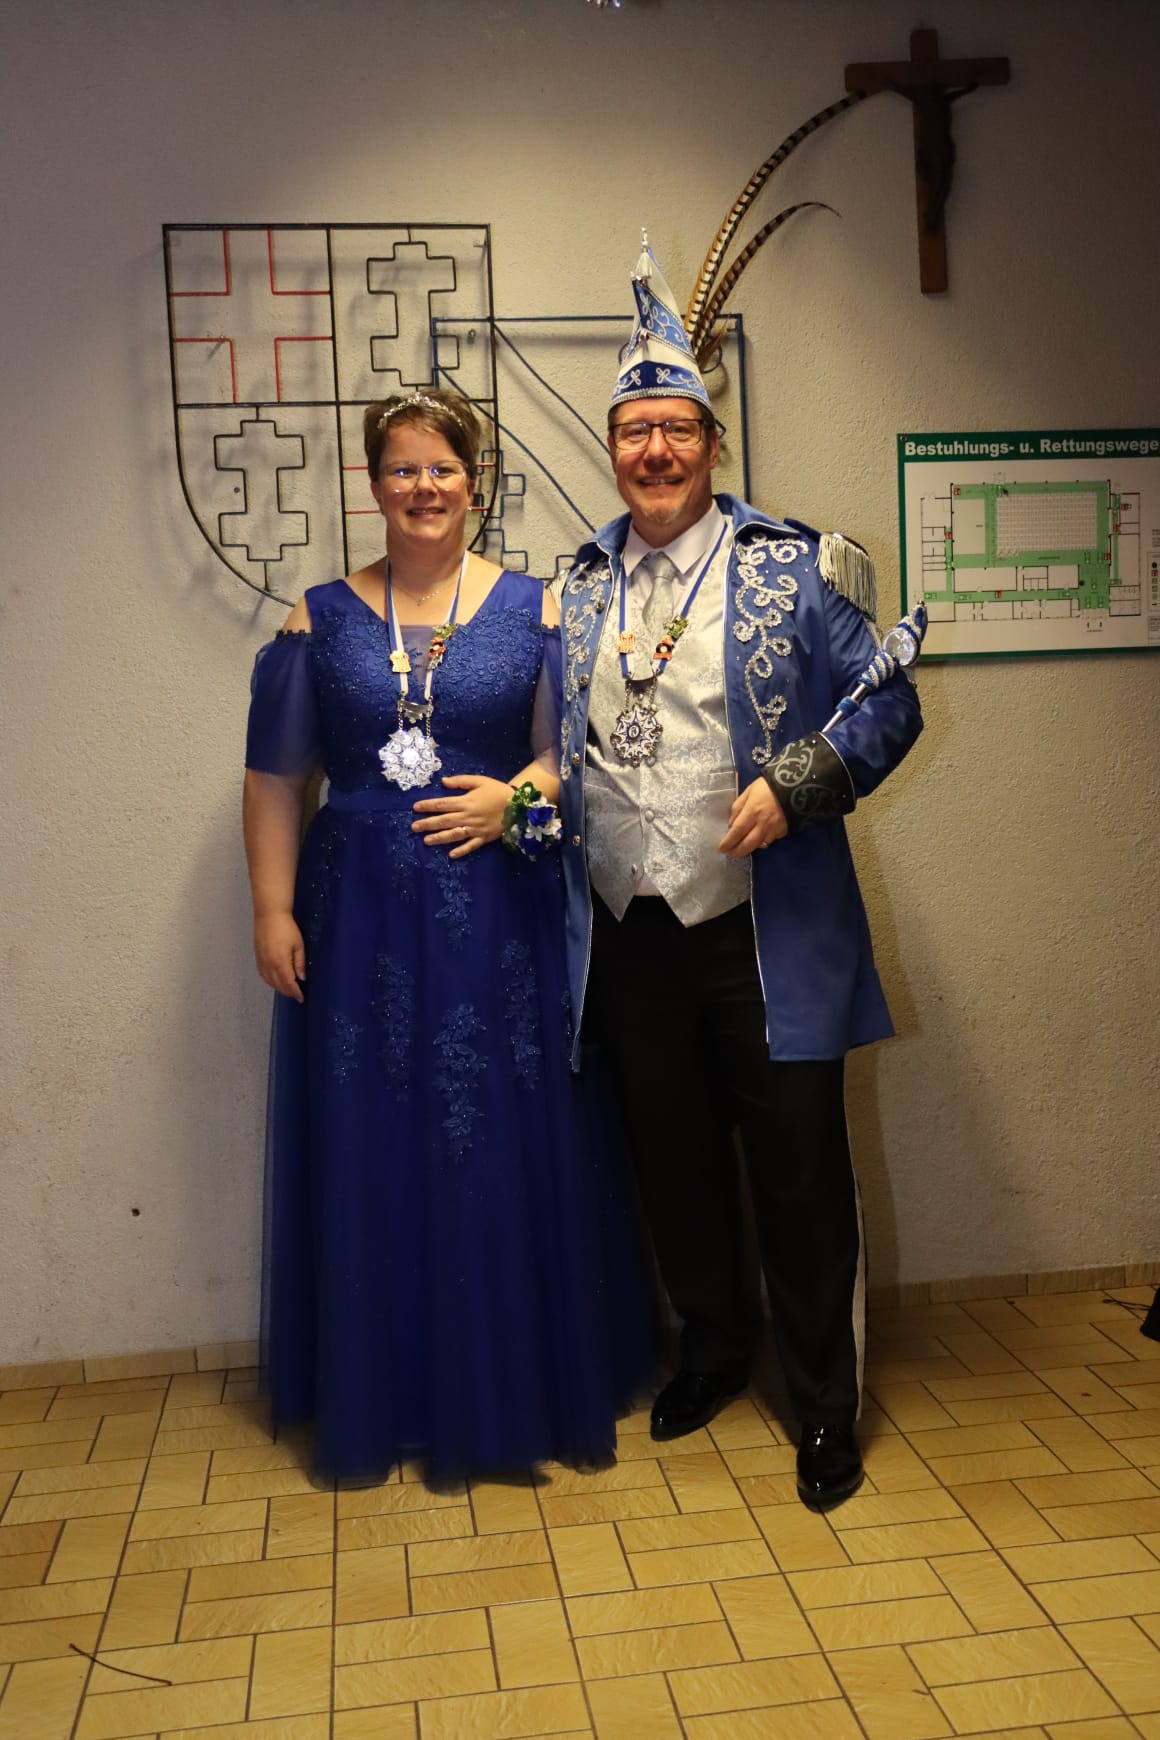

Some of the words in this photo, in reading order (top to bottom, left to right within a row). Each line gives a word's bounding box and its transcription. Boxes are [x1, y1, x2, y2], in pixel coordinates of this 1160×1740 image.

[905, 440, 1014, 457] Bestuhlungs-
[1019, 442, 1035, 454] u.
[1040, 438, 1159, 455] Rettungswege
